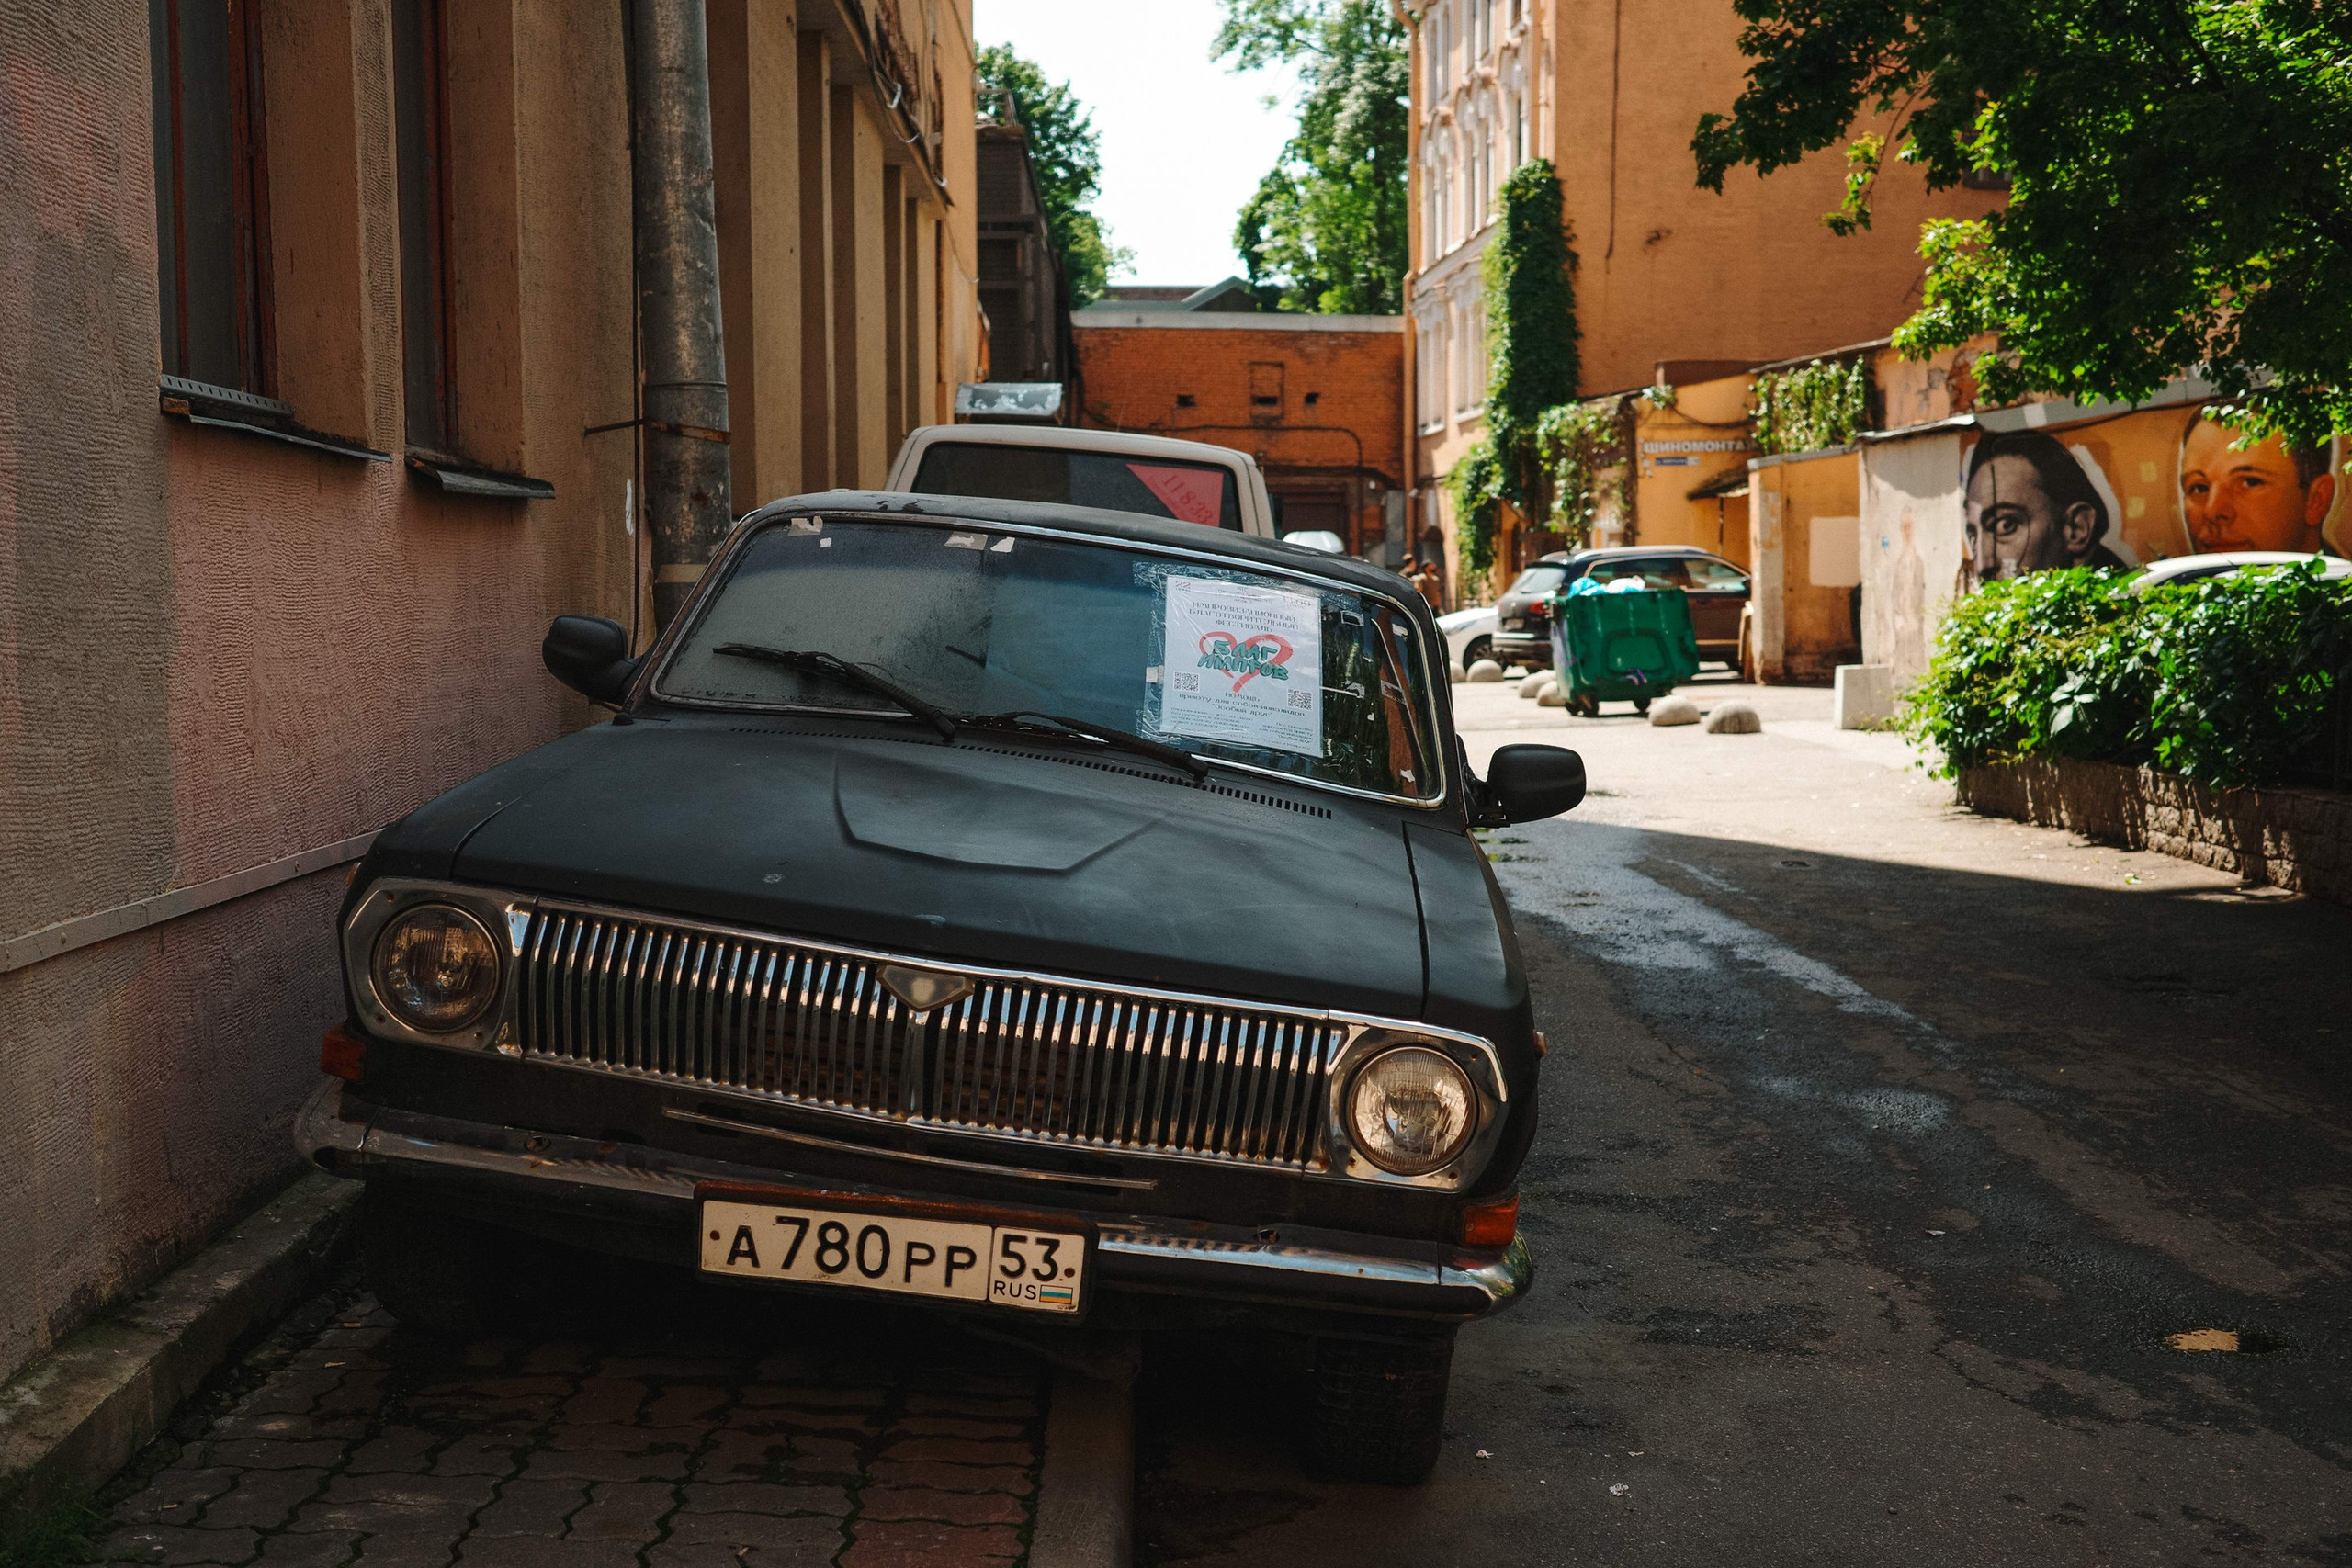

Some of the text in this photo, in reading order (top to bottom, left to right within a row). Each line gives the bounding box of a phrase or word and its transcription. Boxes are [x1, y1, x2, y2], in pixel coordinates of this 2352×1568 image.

[1216, 619, 1273, 633] ФЕСТИВАЛЬ
[1213, 639, 1278, 660] БЛАГ
[1197, 653, 1289, 681] ИМПРОВ
[1000, 1234, 1061, 1282] 53
[993, 1280, 1037, 1301] RUS
